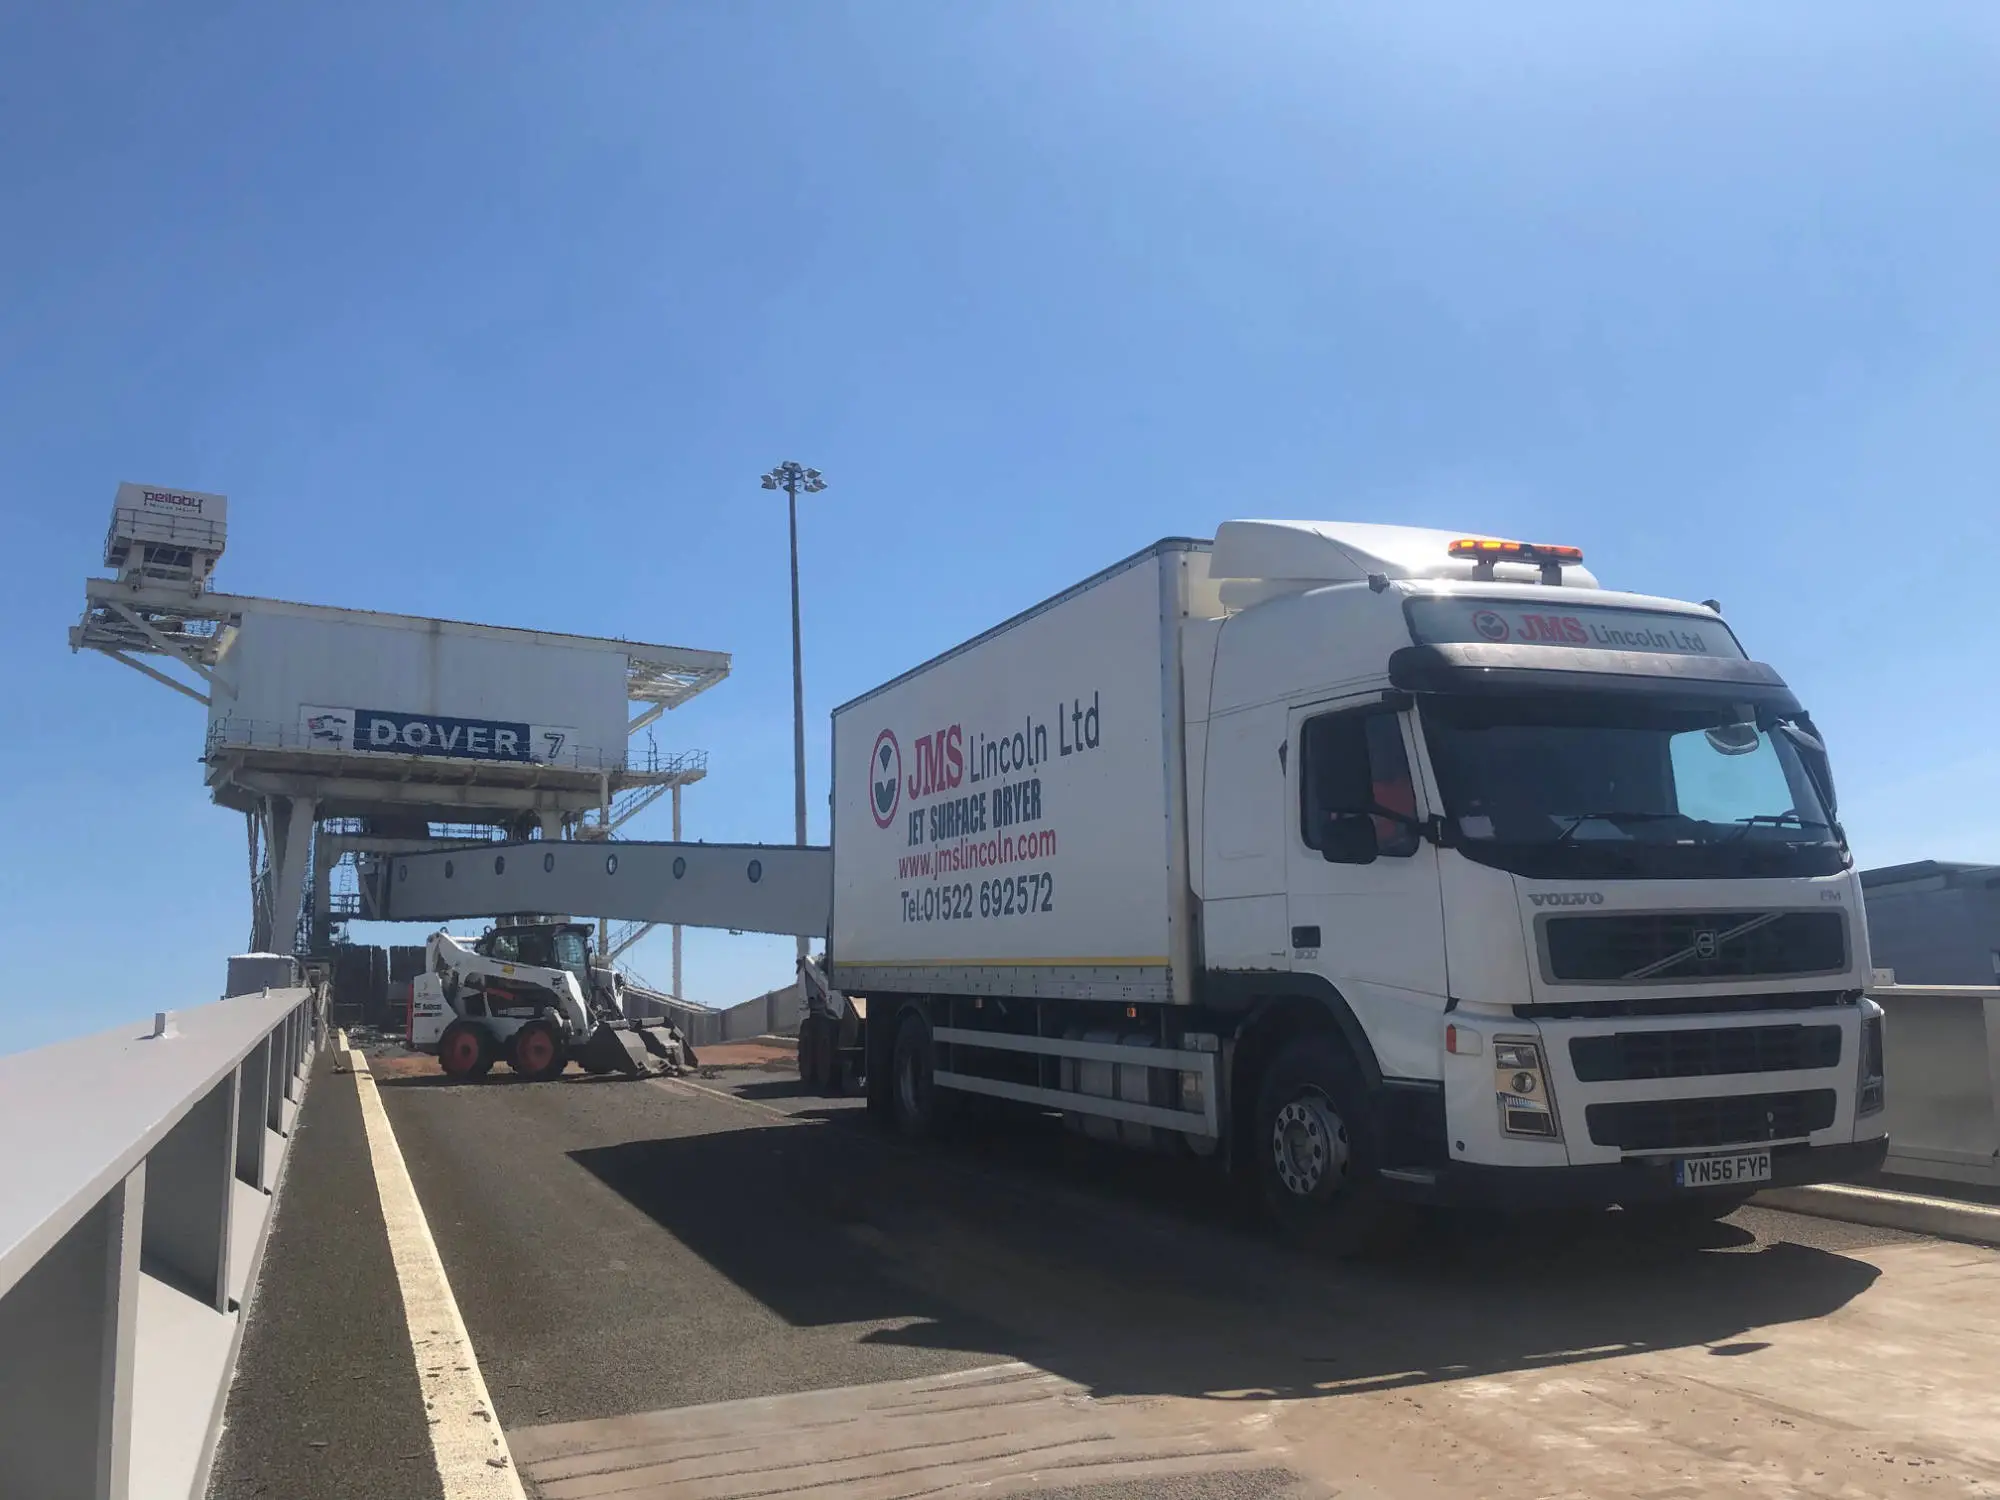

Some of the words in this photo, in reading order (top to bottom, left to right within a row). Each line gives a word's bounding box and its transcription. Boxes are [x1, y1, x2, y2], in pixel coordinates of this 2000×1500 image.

[1517, 614, 1589, 644] JMS
[1589, 624, 1669, 648] Lincoln
[1670, 629, 1707, 652] Ltd
[370, 718, 519, 756] DOVER
[543, 733, 565, 759] 7
[908, 723, 963, 800] JMS
[970, 715, 1047, 783] Lincoln
[1059, 690, 1100, 756] Ltd
[908, 808, 925, 847] JET
[930, 792, 987, 842] SURFACE
[992, 778, 1042, 828] DRYER
[898, 829, 1057, 880] www.jmslincoln.com
[901, 883, 973, 923] Tel:01522
[979, 871, 1053, 918] 692572
[1528, 891, 1604, 907] VOLVO
[1687, 1159, 1733, 1183] YN56
[1736, 1155, 1768, 1179] FYP
